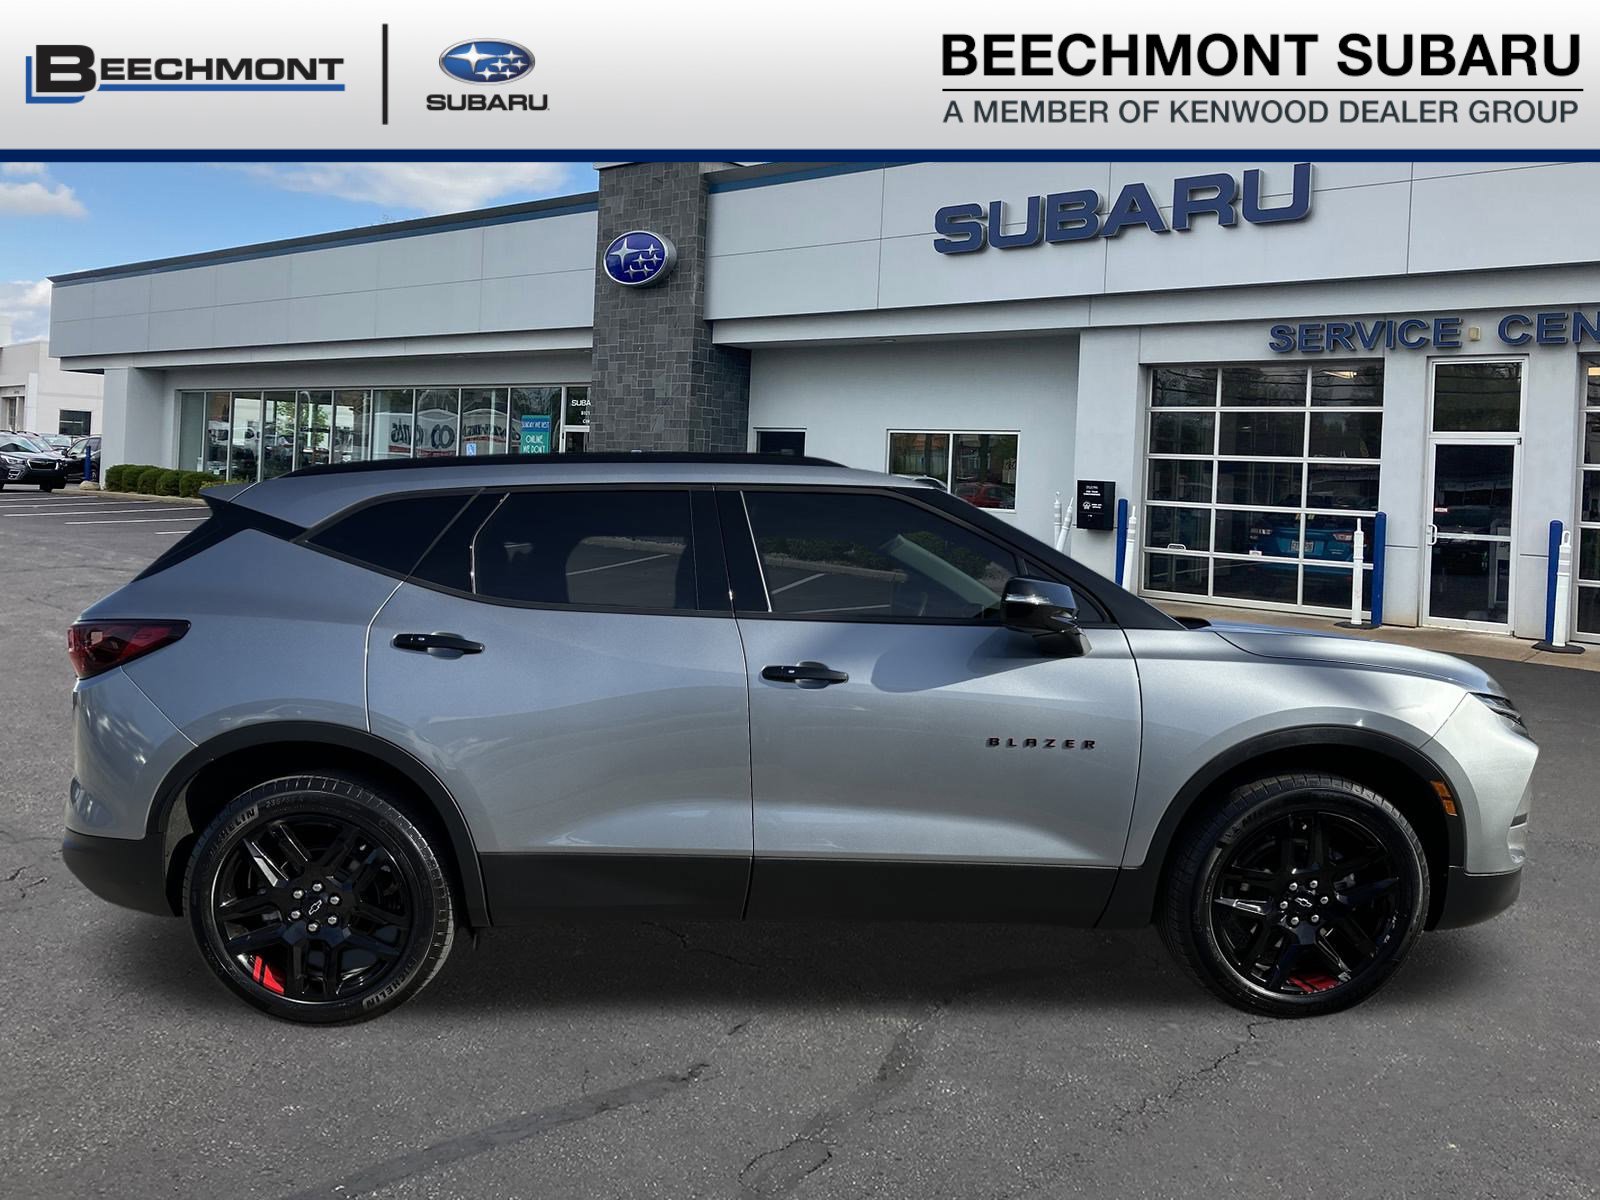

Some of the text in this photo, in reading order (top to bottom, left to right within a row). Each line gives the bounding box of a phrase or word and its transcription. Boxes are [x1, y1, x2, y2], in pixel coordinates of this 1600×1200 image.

[933, 162, 1315, 255] SUBARU
[1268, 310, 1600, 352] SERVICE CEN
[986, 737, 1096, 750] BLAZER
